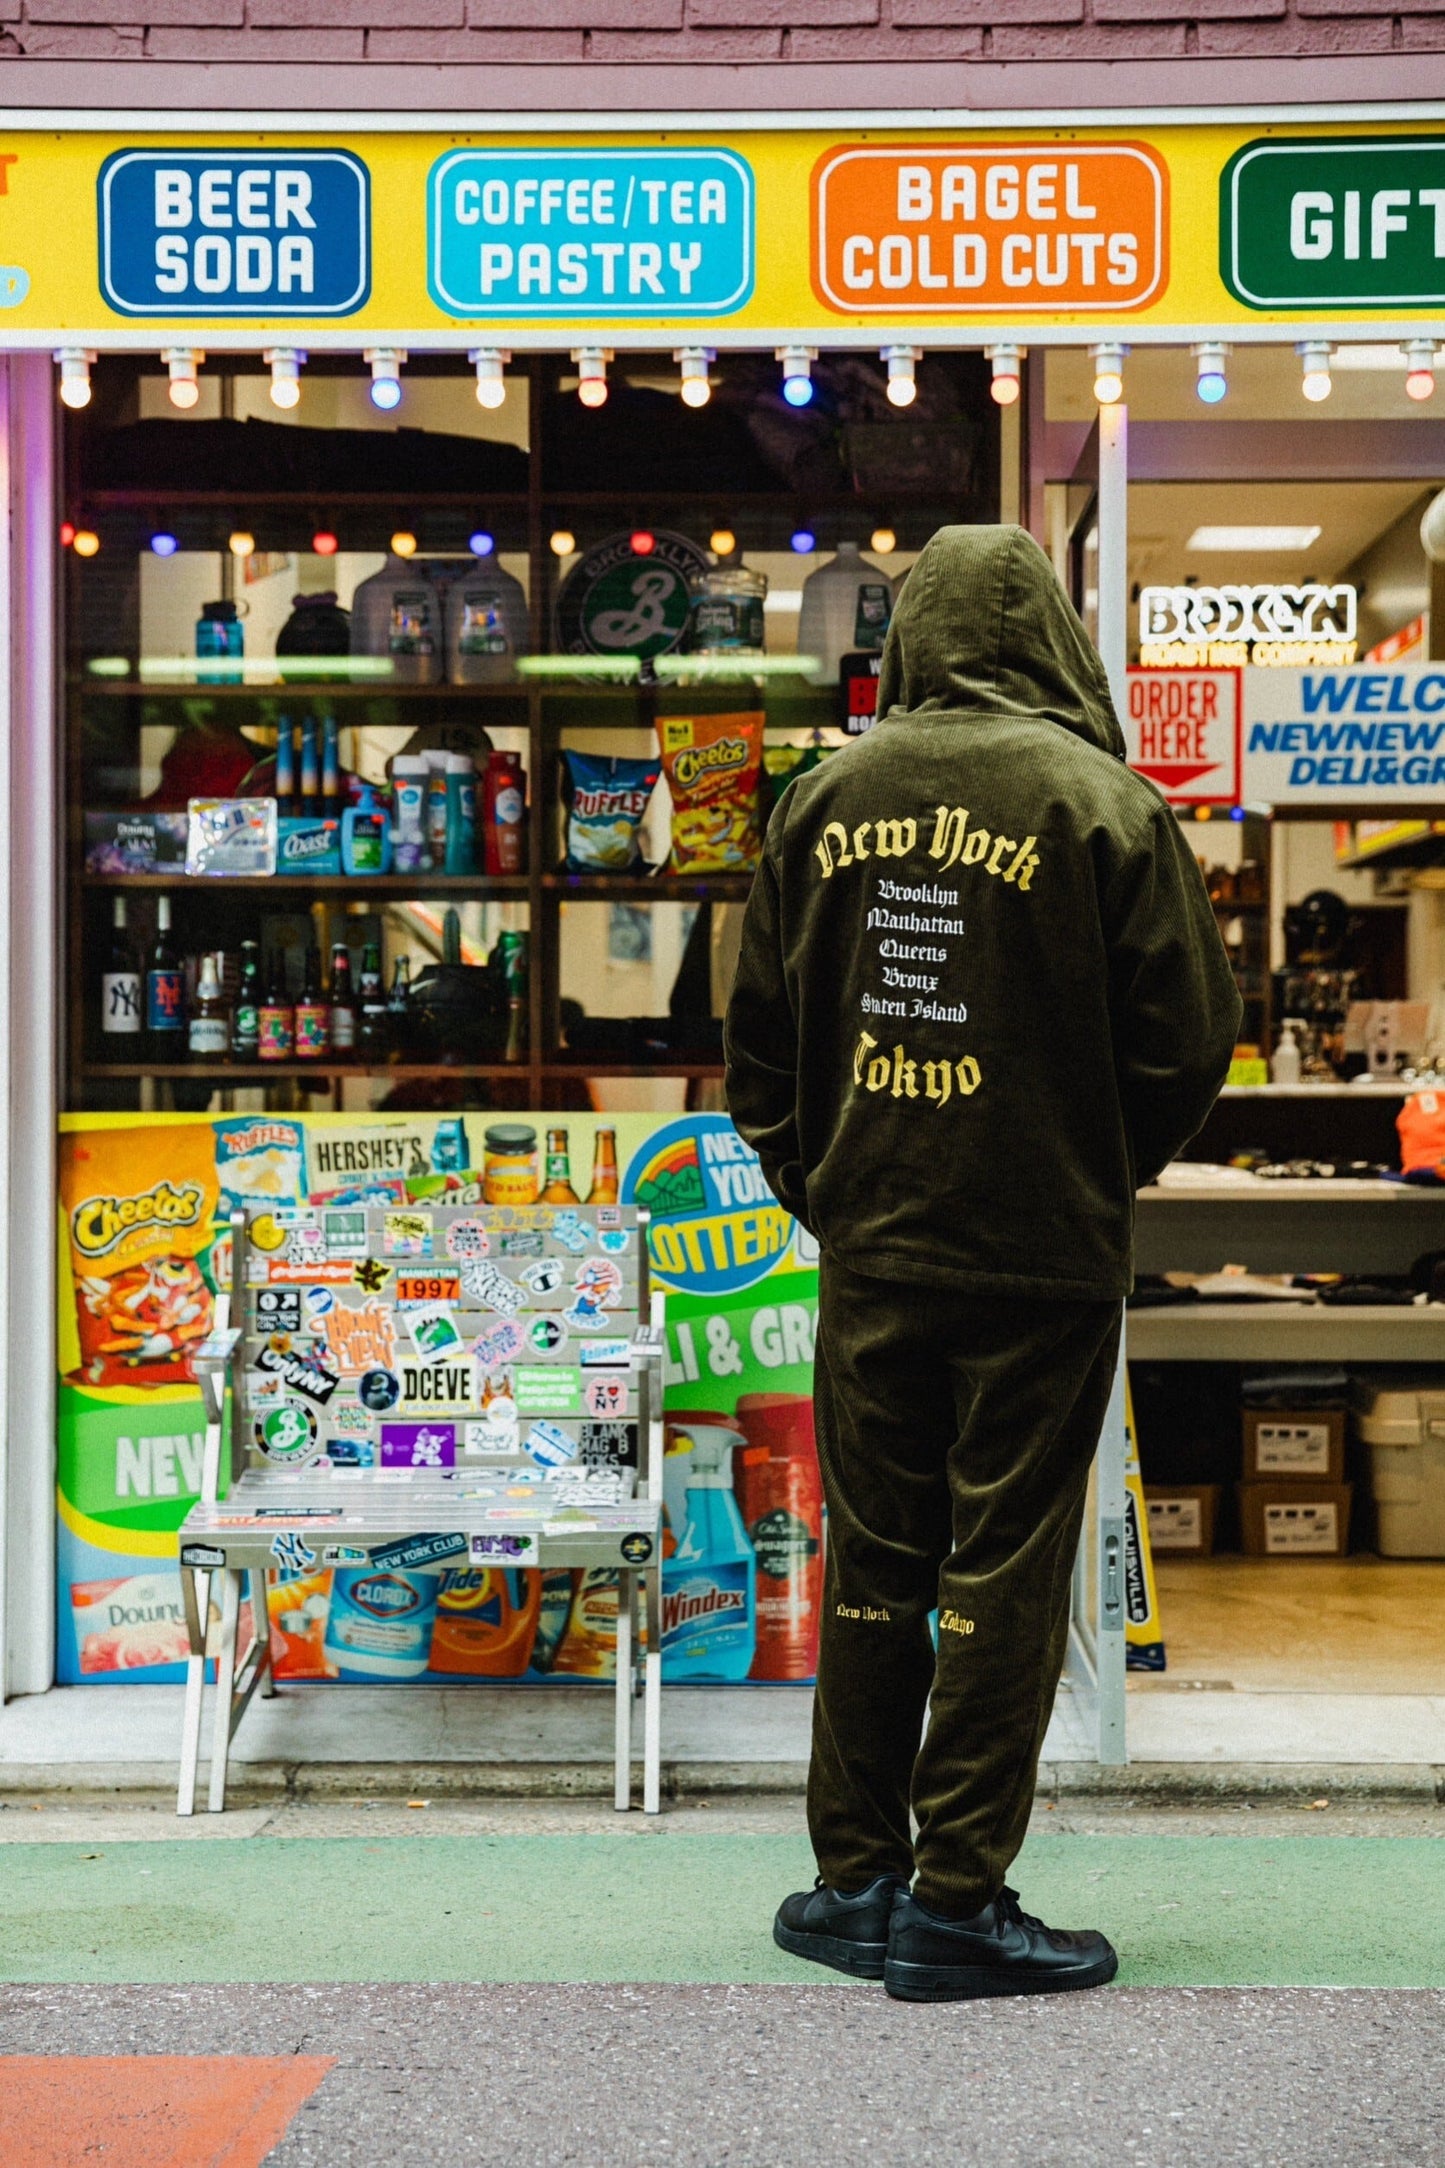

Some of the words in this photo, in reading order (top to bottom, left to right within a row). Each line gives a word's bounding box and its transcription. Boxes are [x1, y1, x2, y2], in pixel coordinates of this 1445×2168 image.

[155, 169, 317, 229] BEER
[897, 164, 1097, 222] BAGEL
[154, 235, 315, 293] SODA
[480, 242, 702, 295] PASTRY
[842, 234, 988, 289] COLD
[1001, 232, 1138, 287] CUTS
[1129, 680, 1219, 718] ORDER
[1140, 721, 1208, 759] HERE
[674, 738, 747, 787] Cheetos
[815, 817, 917, 878] New
[928, 805, 1041, 891] York
[877, 879, 959, 906] Brooklyn
[866, 907, 965, 935] Manhattan
[878, 939, 947, 963] Queens
[882, 967, 939, 993] Bronx
[861, 992, 906, 1017] Staten
[909, 999, 967, 1024] Island
[853, 1030, 982, 1110] Tokyo
[317, 1136, 423, 1173] HERSHEY'S
[73, 1182, 201, 1254] Cheetos
[400, 1280, 457, 1299] 1997
[705, 1314, 744, 1377] &
[402, 1543, 433, 1563] YORK
[433, 1533, 464, 1556] CLUB
[438, 1567, 485, 1593] Tide
[662, 1586, 745, 1636] Windex
